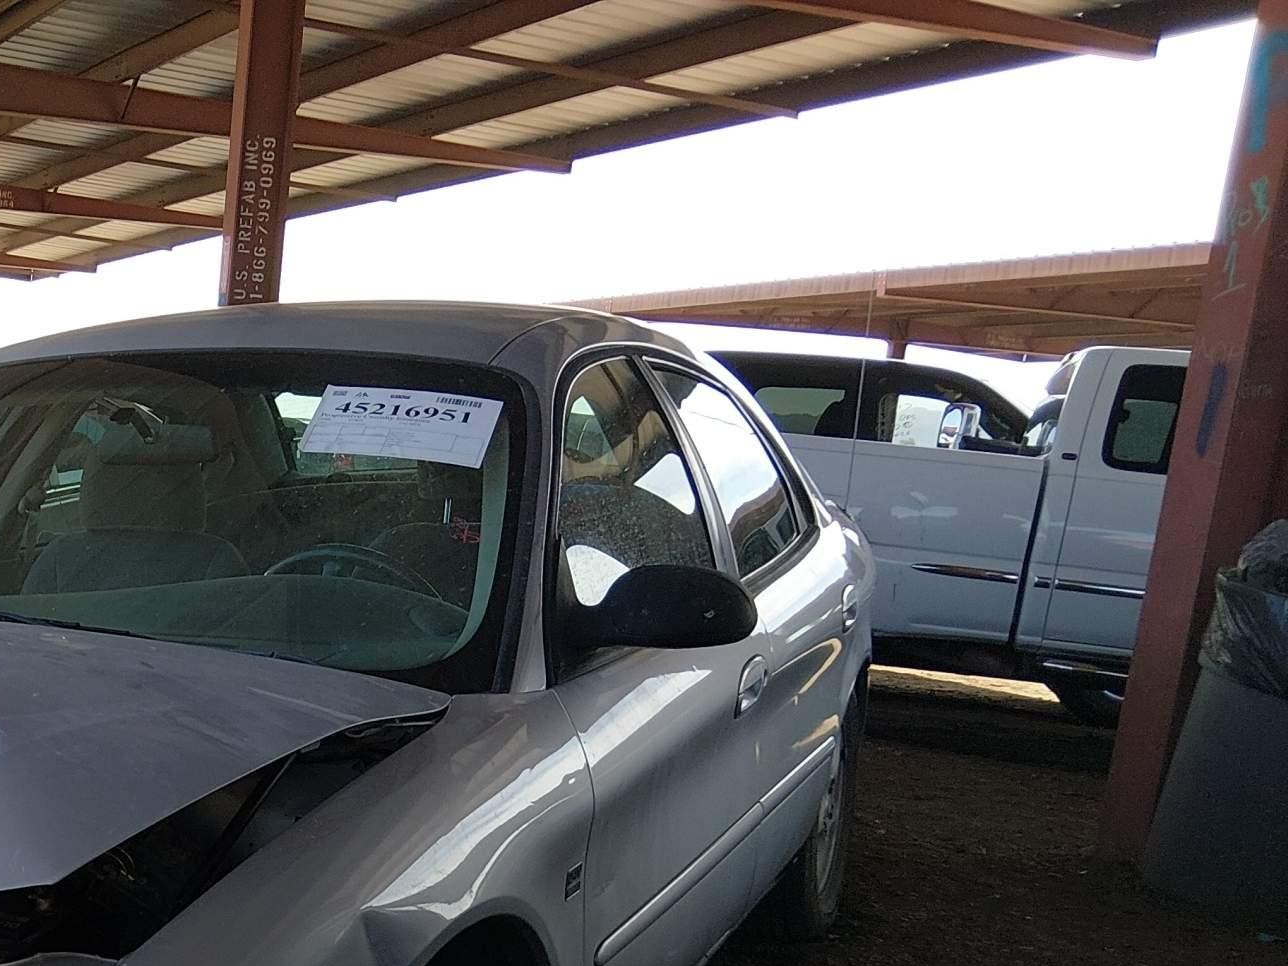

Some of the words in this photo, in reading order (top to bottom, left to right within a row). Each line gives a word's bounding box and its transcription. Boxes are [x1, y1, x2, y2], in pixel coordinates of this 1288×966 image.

[245, 135, 261, 170] INC.
[238, 181, 256, 254] PREFAB
[249, 137, 277, 300] 1-866-799-0969
[233, 264, 249, 300] U.S.
[334, 402, 471, 424] 45216951
